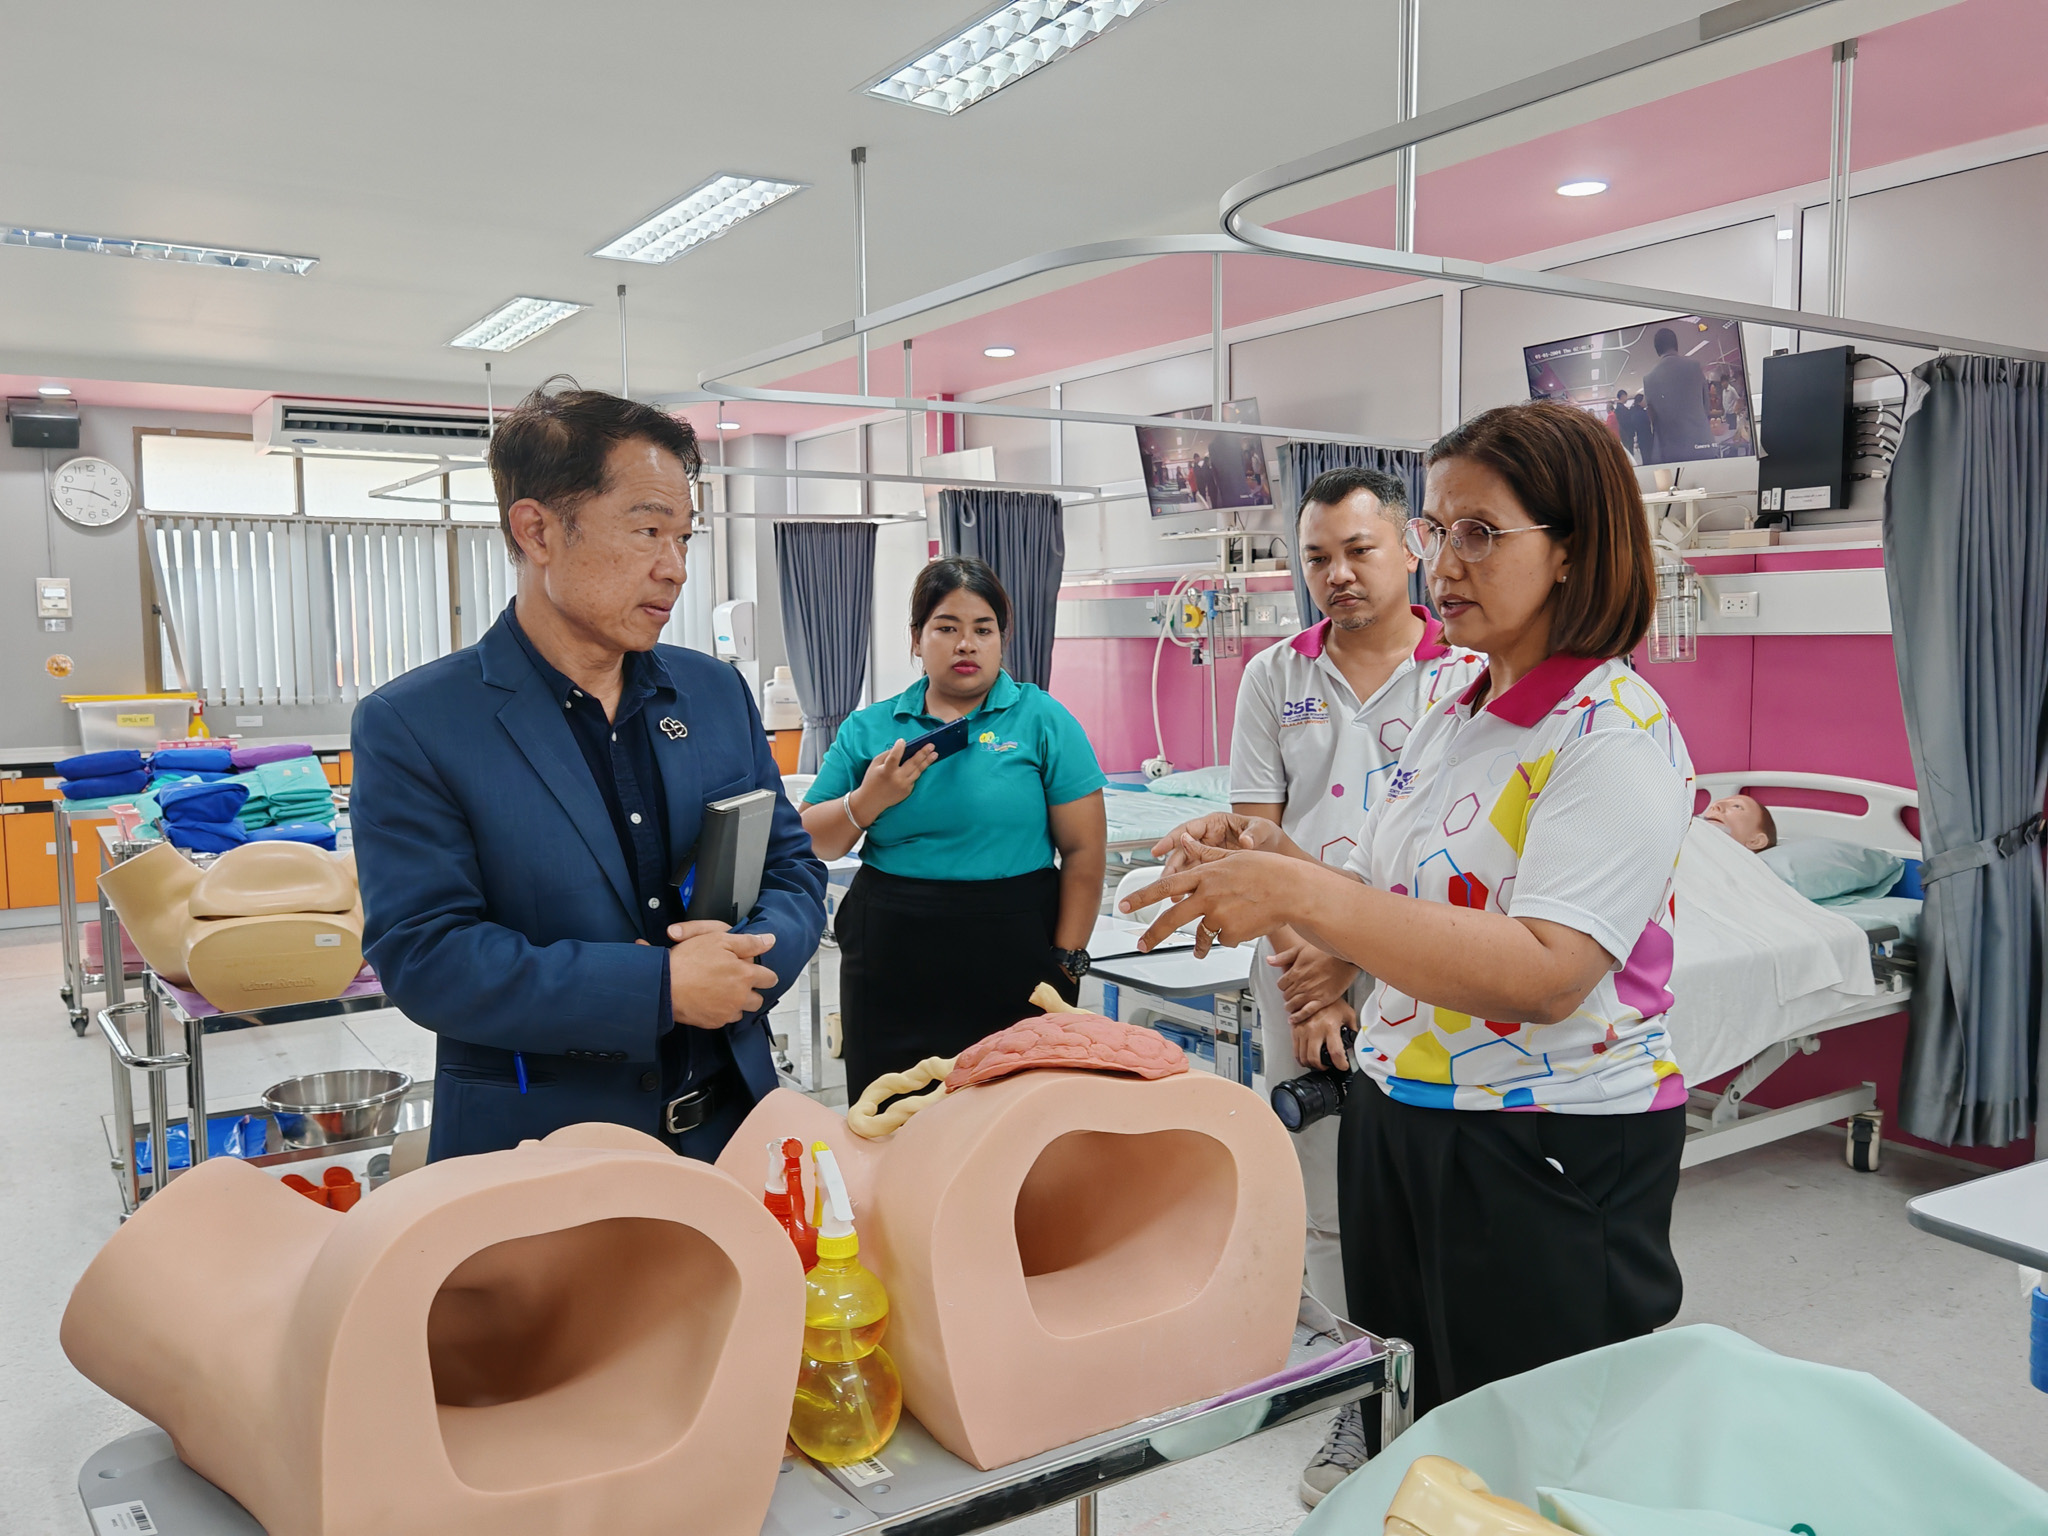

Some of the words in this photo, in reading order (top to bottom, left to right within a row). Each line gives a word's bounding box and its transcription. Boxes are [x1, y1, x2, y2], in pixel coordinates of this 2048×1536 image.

[74, 466, 81, 474] 11
[86, 464, 96, 472] 12
[64, 475, 74, 483] 10
[110, 477, 118, 485] 2
[61, 486, 69, 494] 9
[114, 489, 122, 497] 3
[65, 498, 73, 506] 8
[76, 507, 83, 515] 7
[88, 511, 96, 519] 6
[101, 509, 109, 517] 5
